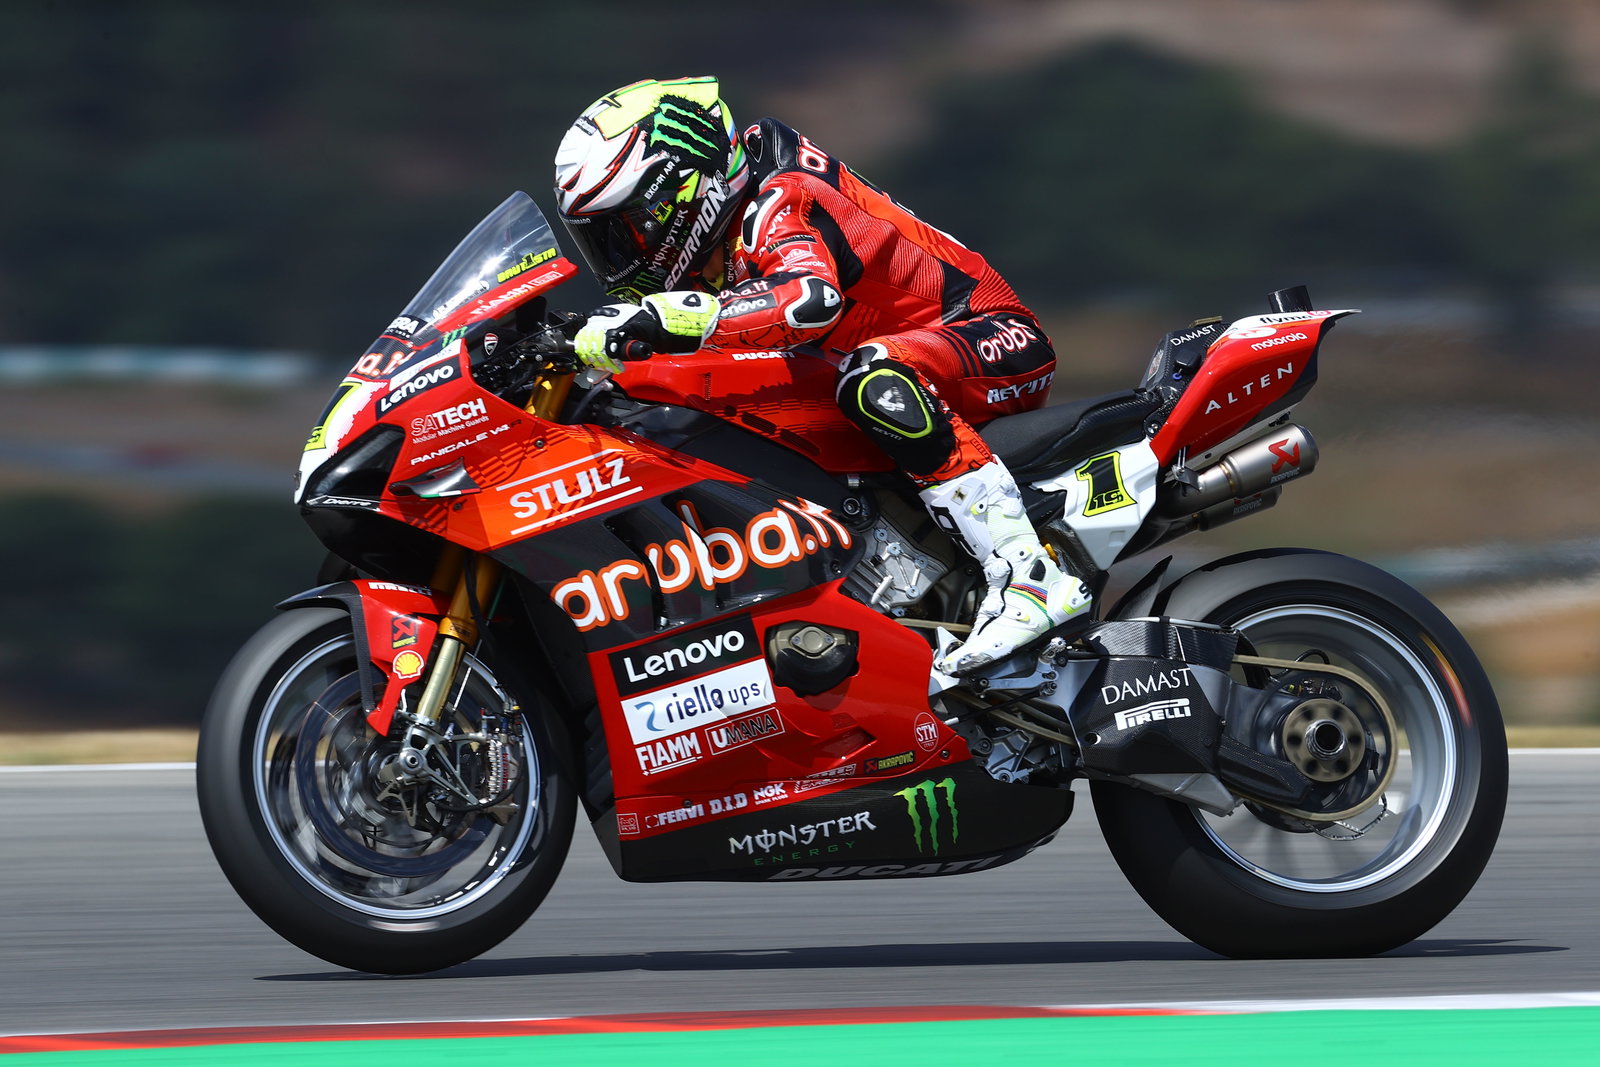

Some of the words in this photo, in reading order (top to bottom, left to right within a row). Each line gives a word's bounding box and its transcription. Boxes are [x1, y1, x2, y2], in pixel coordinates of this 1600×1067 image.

[662, 160, 677, 174] AIR
[663, 174, 727, 292] SCORPION
[1170, 324, 1216, 346] DAMAST
[1251, 331, 1308, 352] motorola
[732, 351, 796, 361] DUCATI
[381, 365, 454, 412] Lenovo
[1204, 362, 1293, 415] ALTEN
[411, 398, 488, 437] SATECH
[439, 423, 466, 437] Machine
[410, 431, 489, 465] PANIGALE
[509, 457, 631, 519] STULZ
[1075, 450, 1138, 517] 1
[550, 495, 852, 632] aruba.it
[623, 630, 745, 683] Lenovo
[665, 684, 725, 723] riello
[727, 682, 761, 706] ups
[1101, 667, 1191, 705] DAMAST
[916, 723, 938, 742] STM
[1114, 698, 1191, 731] PIRELLI
[634, 731, 702, 770] FIAMM
[711, 713, 778, 748] UMANA
[658, 803, 705, 826] FERVI
[708, 792, 748, 815] D.I.D
[753, 783, 787, 800] NGK
[728, 810, 877, 855] MONSTER
[755, 841, 856, 867] ENERGY
[768, 854, 1004, 881] DUCATI
